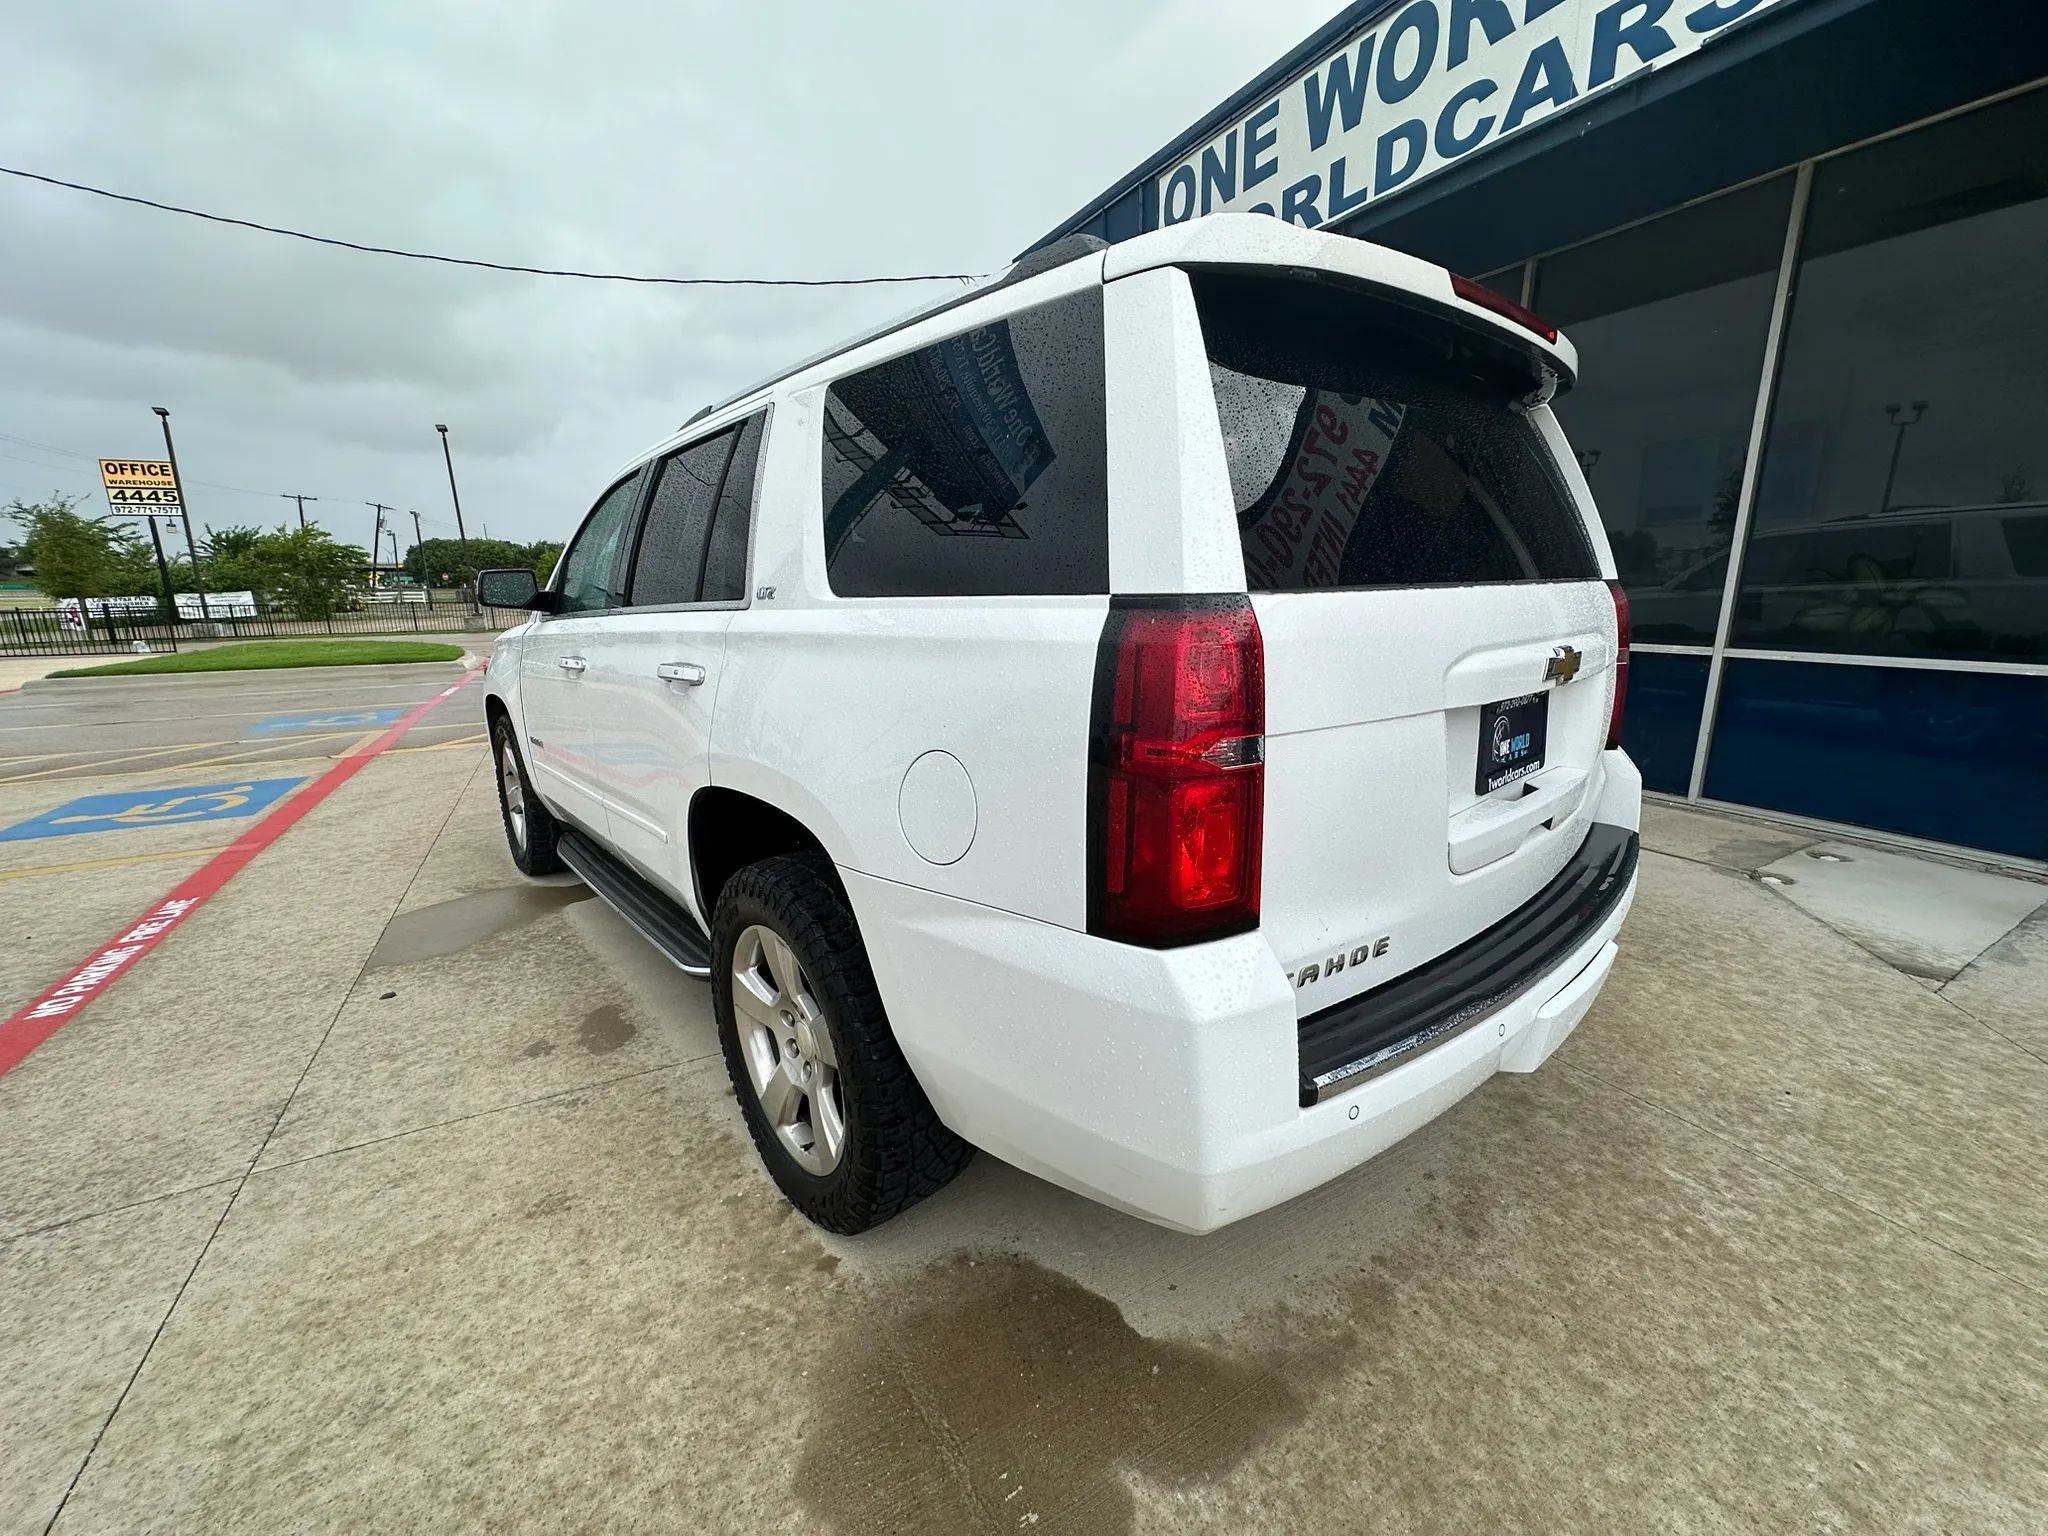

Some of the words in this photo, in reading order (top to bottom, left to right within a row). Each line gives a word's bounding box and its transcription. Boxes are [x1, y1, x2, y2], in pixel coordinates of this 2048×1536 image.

[1164, 101, 1280, 227] ONE
[1303, 0, 1568, 152] WOR
[104, 462, 171, 476] OFFICE
[112, 489, 178, 503] 4445
[114, 506, 179, 514] 972-771-7577
[1500, 739, 1511, 756] ONE
[1511, 733, 1530, 753] WORLD
[1488, 760, 1540, 791] 1worldcars.com
